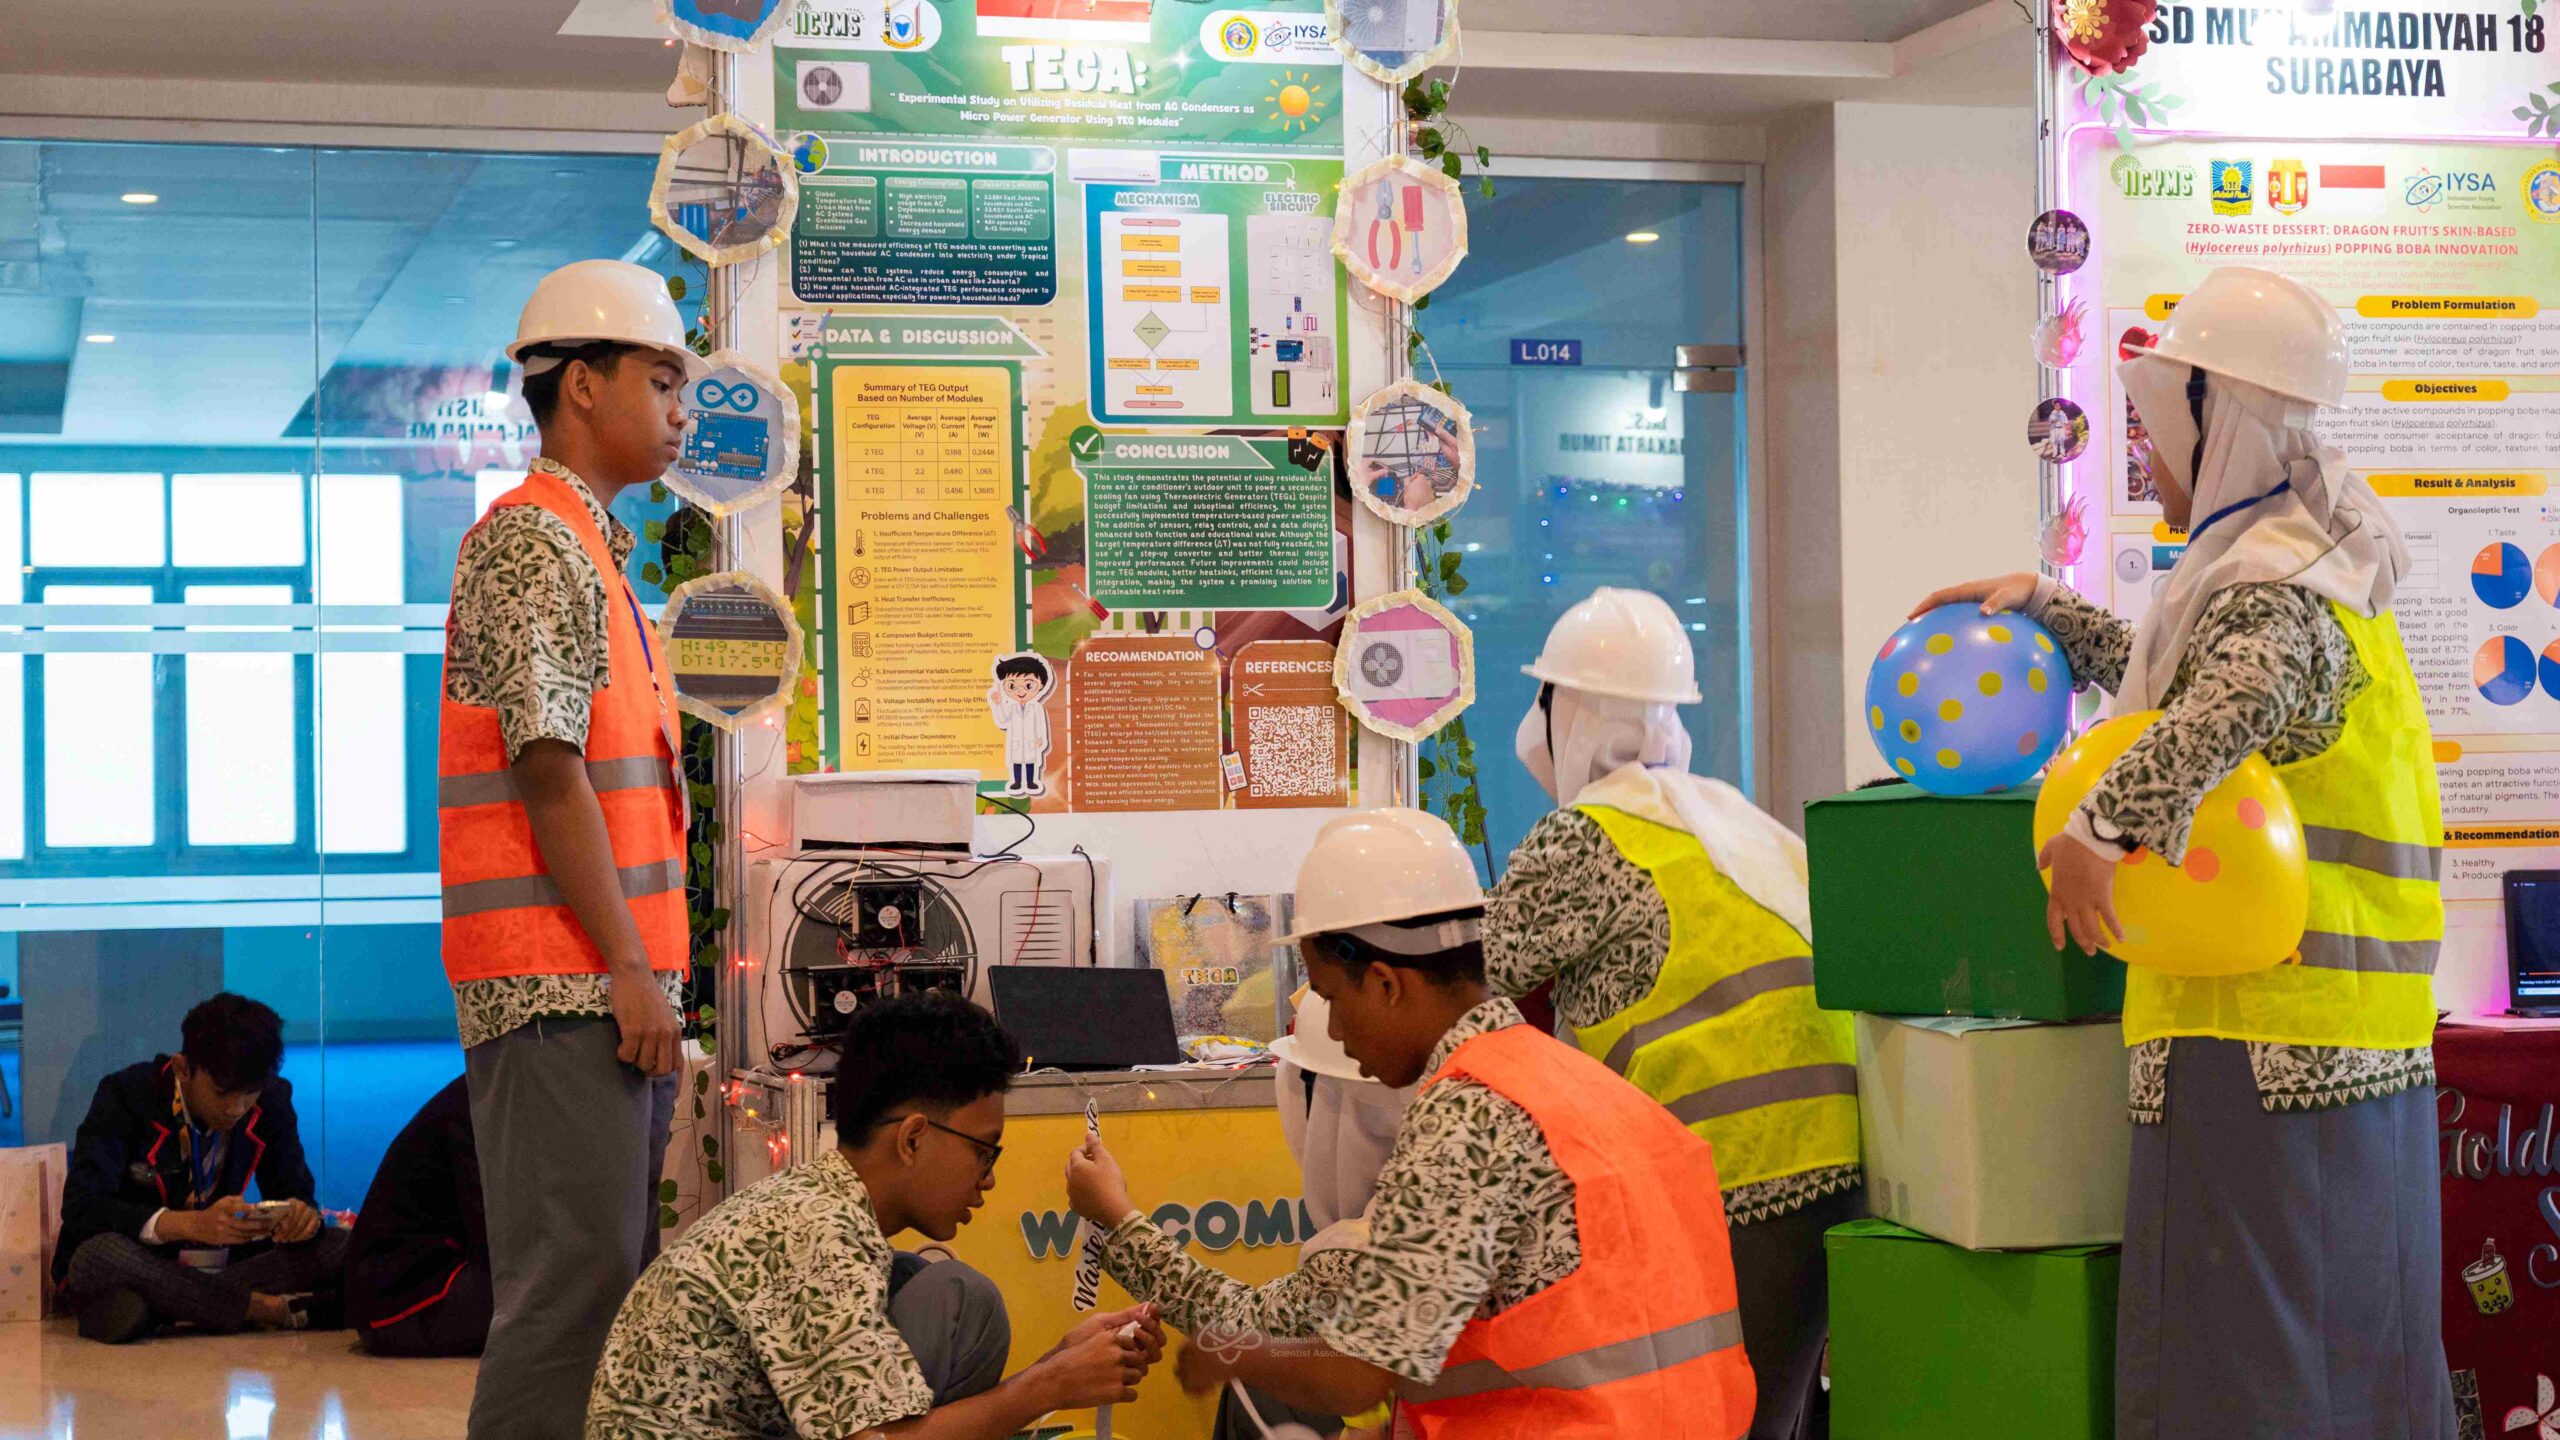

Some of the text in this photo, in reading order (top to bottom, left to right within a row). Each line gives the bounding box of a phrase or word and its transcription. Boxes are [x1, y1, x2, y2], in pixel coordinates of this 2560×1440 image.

[2148, 5, 2194, 45] SD
[2507, 14, 2545, 54] 18
[2266, 56, 2446, 97] SURABAYA
[898, 92, 966, 105] Experimental
[969, 94, 1000, 107] Study
[1003, 97, 1018, 106] on
[1064, 95, 1107, 107] Residual
[1110, 98, 1133, 109] Heat
[1135, 99, 1160, 110] from
[1164, 101, 1177, 111] AC
[1181, 101, 1239, 113] Condensers
[1243, 105, 1254, 113] as
[959, 109, 990, 121] Micro
[992, 112, 1026, 122] Power
[1029, 113, 1081, 123] Generator
[1085, 114, 1113, 126] Using
[1116, 115, 1134, 125] TEG
[858, 148, 997, 165] INTRODUCTION
[1180, 163, 1269, 182] METHOD
[2447, 172, 2496, 192] IYSA
[1115, 192, 1200, 207] MECHANISM
[1264, 193, 1319, 205] ELECTRIC
[1269, 202, 1315, 212] SIRCUIT
[2186, 223, 2268, 234] ZERO-WASTE
[2272, 224, 2329, 235] DESSERT:
[2333, 224, 2389, 235] DRAGON
[2442, 225, 2515, 236] SKIN-BASED
[2185, 241, 2258, 256] (Hylocereus
[2335, 242, 2392, 254] POPPING
[2396, 243, 2431, 254] BOBA
[2435, 244, 2517, 255] INNOVATION
[895, 250, 935, 258] condensers
[957, 251, 992, 260] electricity
[996, 252, 1017, 260] under
[1021, 253, 1048, 261] tropical
[2391, 299, 2515, 309] Problem Formulation
[825, 328, 1015, 345] DATA & DISCUSSION
[1522, 343, 1570, 361] L.014
[863, 383, 968, 393] Summary of TEG Output
[2414, 383, 2477, 394] Objectives
[857, 393, 884, 402] Based
[899, 393, 933, 402] Number
[935, 394, 944, 402] of
[946, 394, 983, 402] Modules
[939, 414, 965, 422] Average
[970, 414, 996, 422] Average
[851, 422, 895, 430] Configuration
[902, 423, 926, 431] Voltage
[1115, 444, 1230, 459] CONCLUSION
[870, 467, 884, 475] TEG
[1093, 473, 1110, 481] This
[1113, 474, 1133, 483] study
[1191, 473, 1204, 481] the
[1206, 474, 1241, 482] potential
[1254, 474, 1274, 483] using
[1309, 473, 1326, 481] heat
[2414, 477, 2515, 489] Result & Analysis
[861, 511, 989, 522] Problems and Challenges
[2447, 506, 2500, 515] Organoleptic
[2130, 561, 2138, 569] 1.
[2496, 623, 2518, 632] Color
[1086, 650, 1204, 663] RECOMMENDATION
[1245, 660, 1333, 673] REFERENCES
[2466, 767, 2504, 778] popping
[2507, 766, 2530, 775] boba
[2485, 779, 2531, 788] attractive
[2449, 791, 2559, 803] of natural pigments. The
[2452, 804, 2491, 815] industry.
[2443, 829, 2559, 841] & Recommendation
[2452, 858, 2495, 868] 3. Healthy
[2452, 871, 2505, 880] 4. Produced
[1073, 1231, 1104, 1312] Waste
